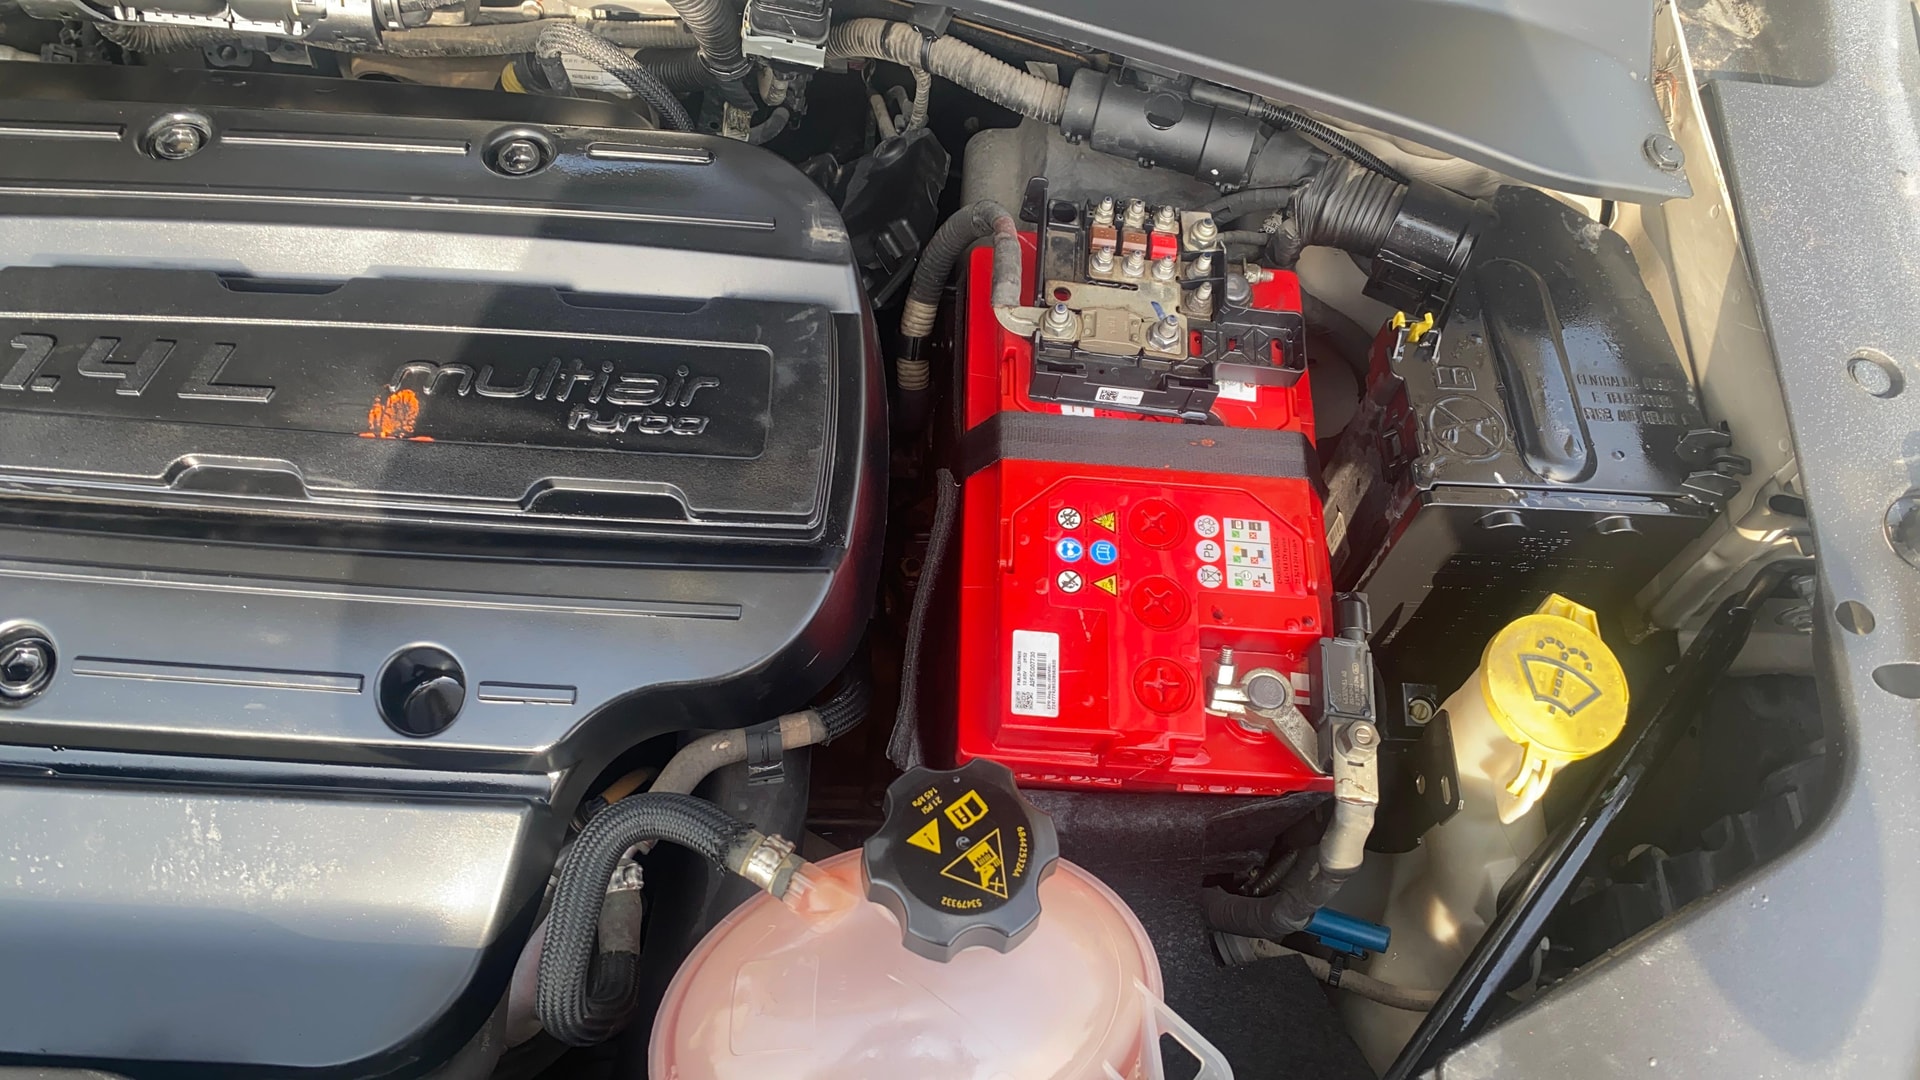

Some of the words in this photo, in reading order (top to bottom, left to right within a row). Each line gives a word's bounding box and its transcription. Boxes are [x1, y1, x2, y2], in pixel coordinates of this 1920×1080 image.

[388, 357, 720, 407] multiair
[568, 403, 710, 435] turbo
[1204, 543, 1214, 559] Pb
[923, 787, 939, 800] 145
[920, 803, 934, 815] PSI
[932, 796, 943, 807] 21
[1011, 826, 1028, 878] 68442532AA
[940, 895, 983, 910] 53479332
